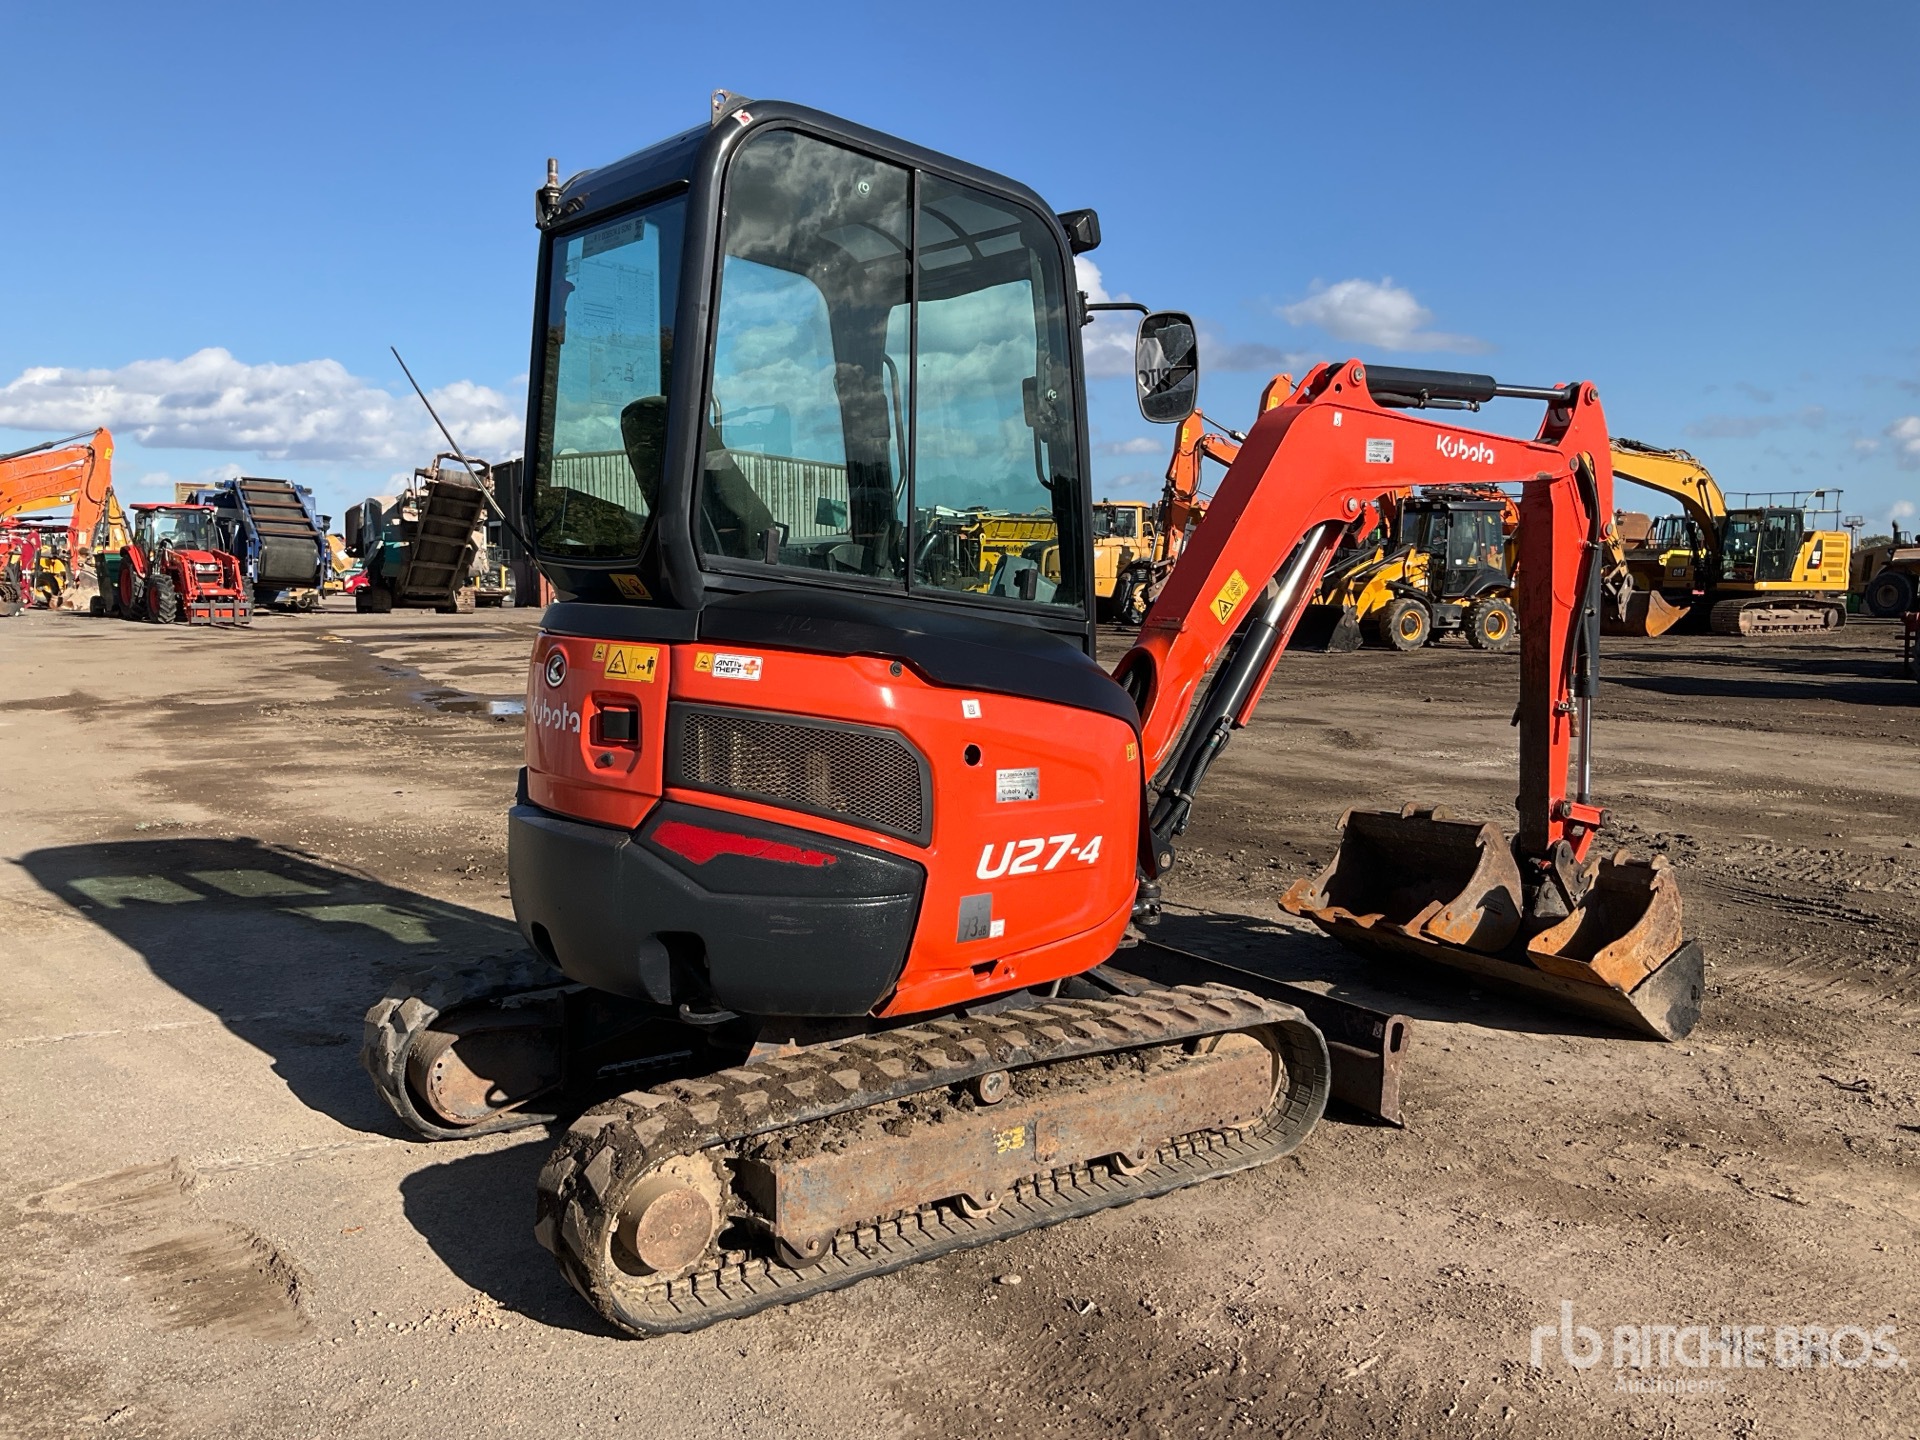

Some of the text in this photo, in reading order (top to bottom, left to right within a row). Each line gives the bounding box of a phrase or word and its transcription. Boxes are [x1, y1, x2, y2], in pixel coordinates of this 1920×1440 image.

[1436, 433, 1495, 465] Kubota
[1672, 568, 1686, 577] CAT
[715, 666, 742, 674] THEFT
[531, 695, 581, 733] Kubota
[976, 833, 1103, 880] U27-4
